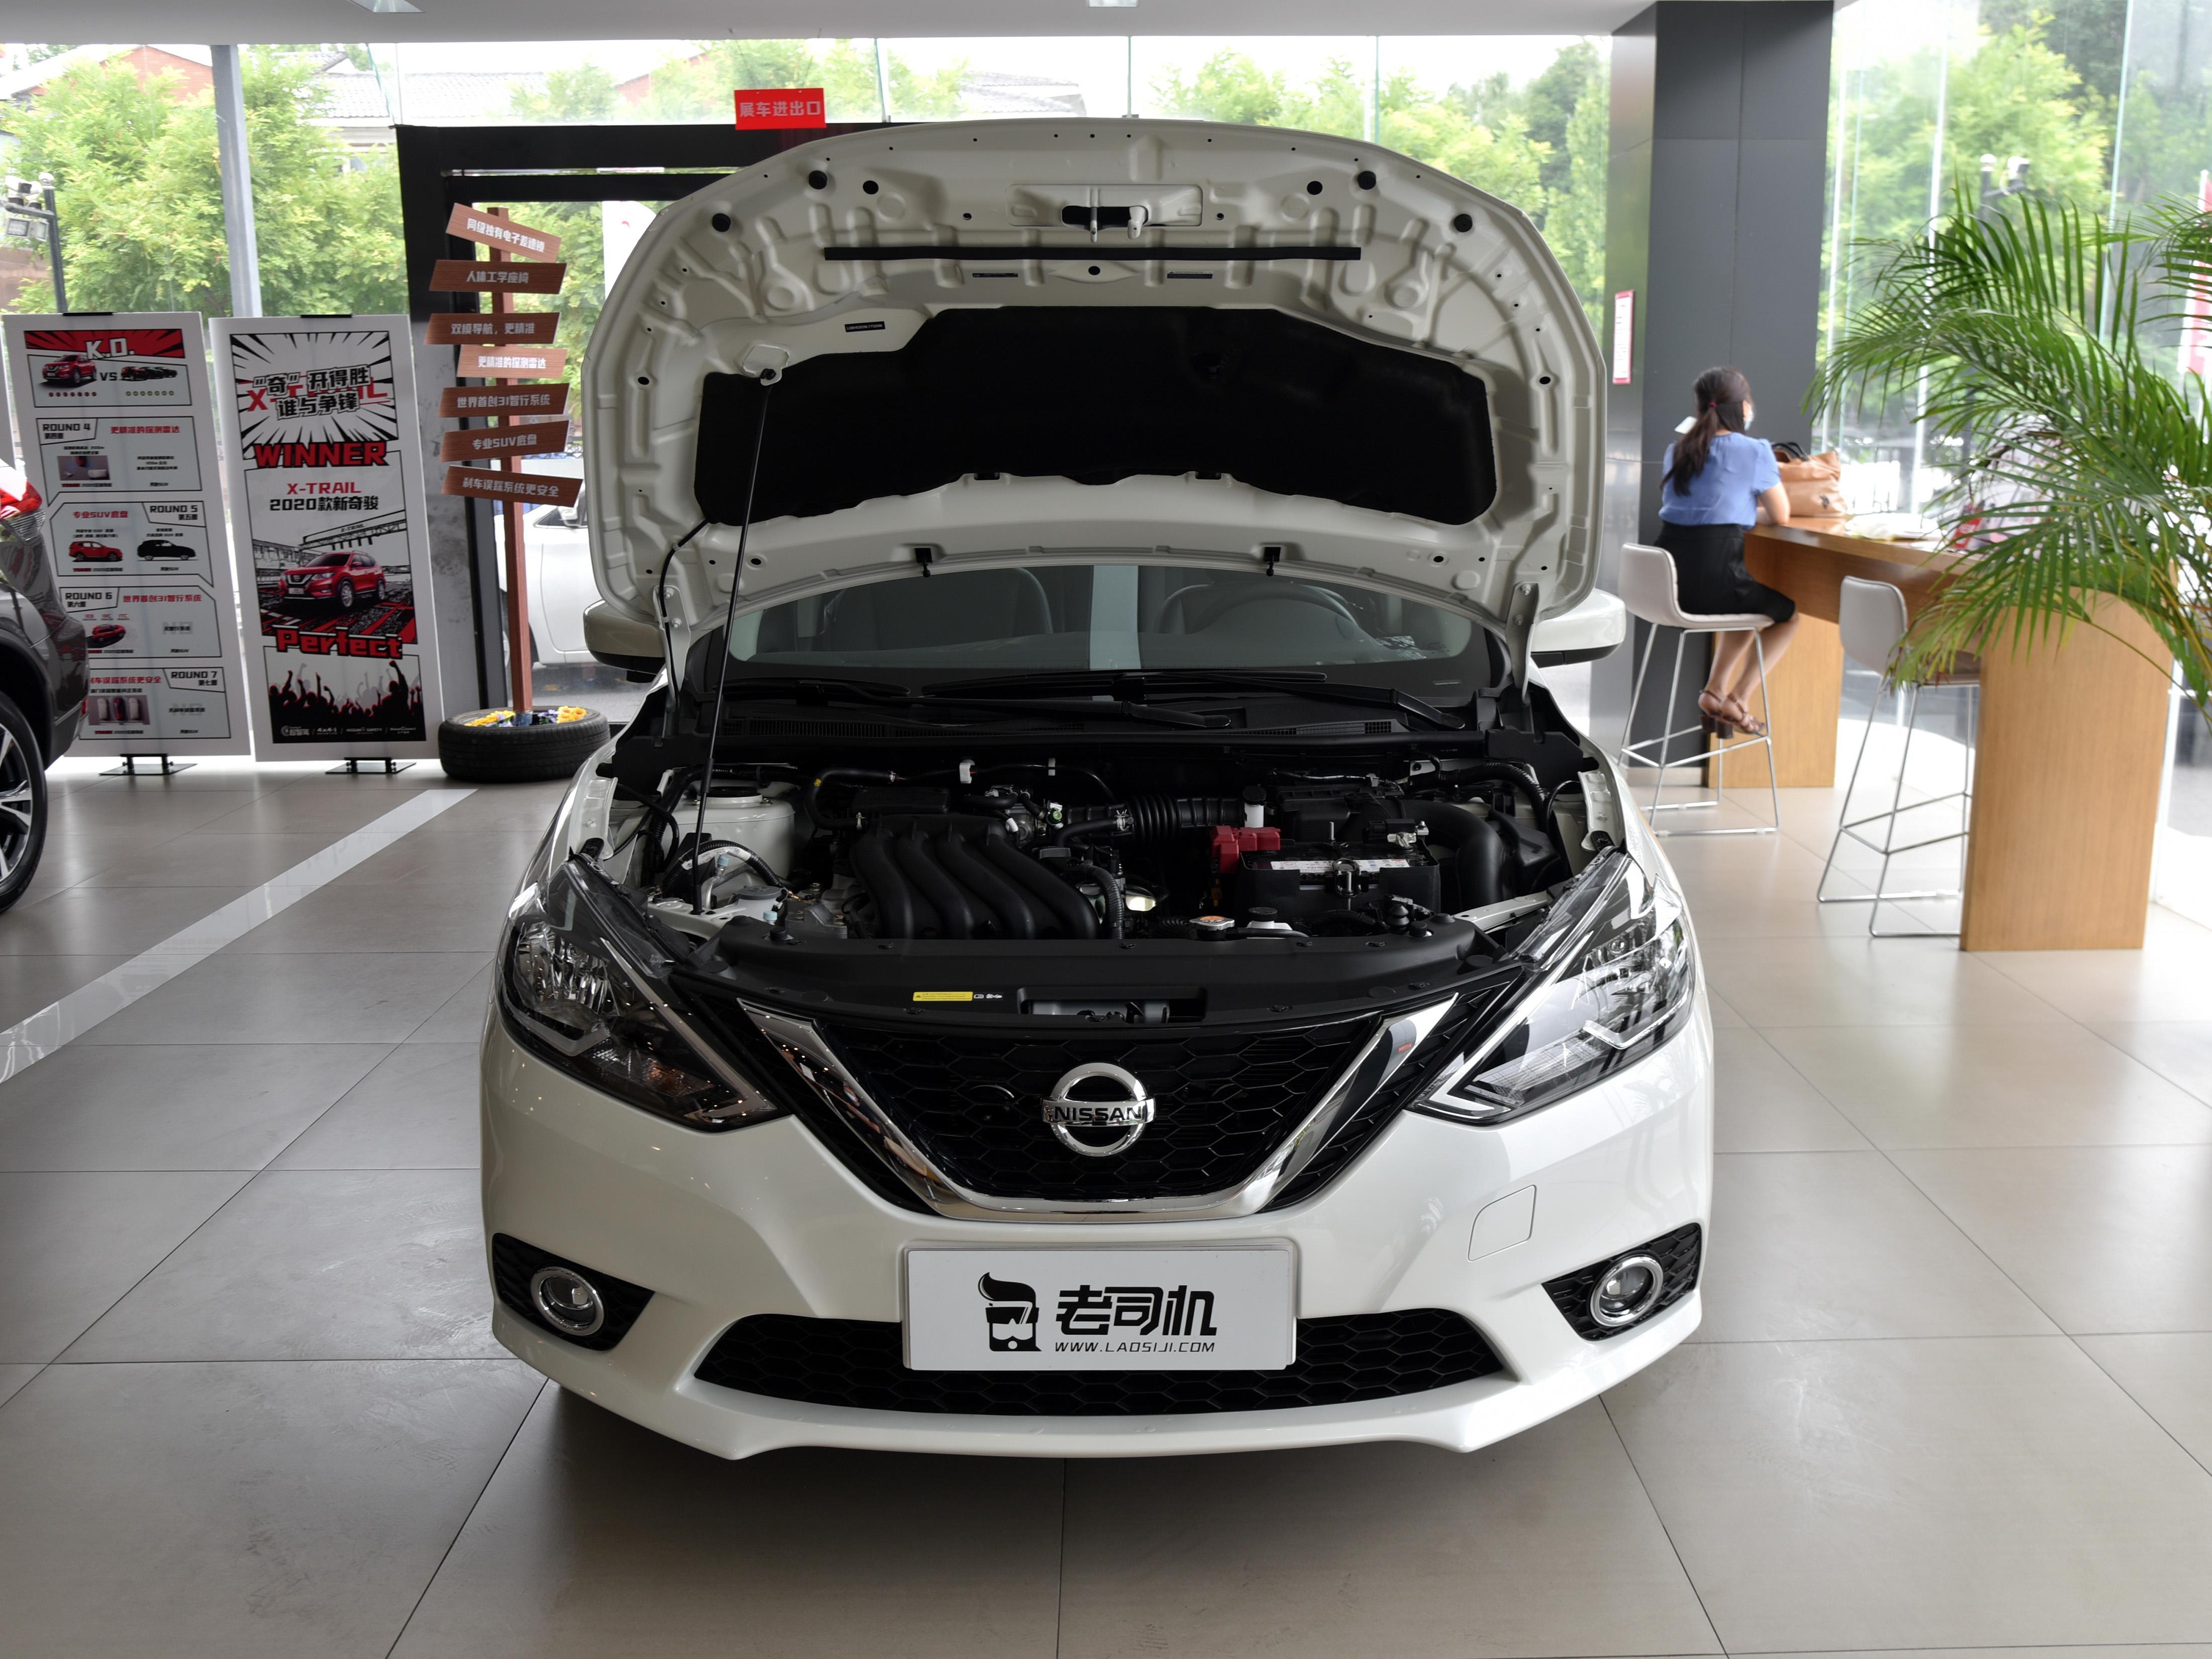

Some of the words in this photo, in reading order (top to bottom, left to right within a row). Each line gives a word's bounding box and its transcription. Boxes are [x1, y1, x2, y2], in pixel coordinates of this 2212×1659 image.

[740, 101, 821, 117] 展车进出口
[466, 270, 529, 284] 人体工学座椅
[478, 356, 546, 368] 更精准的探测雷达
[100, 372, 118, 381] VS
[276, 391, 359, 419] 谁与争锋
[43, 423, 80, 432] ROUND
[83, 423, 91, 431] 4
[472, 434, 537, 450] 专业SUV底盘
[253, 441, 390, 469] WINNER
[287, 481, 361, 495] X-TRAIL
[150, 505, 188, 513] ROUND
[269, 495, 379, 512] 2020款新奇骏
[72, 510, 128, 519] 专业SUV底盘
[276, 627, 403, 659] Perfect
[1054, 1106, 1146, 1122] NISSAN
[1055, 1284, 1218, 1336] 老司机
[1054, 1341, 1216, 1352] WWW.LAOSIJI.COM
